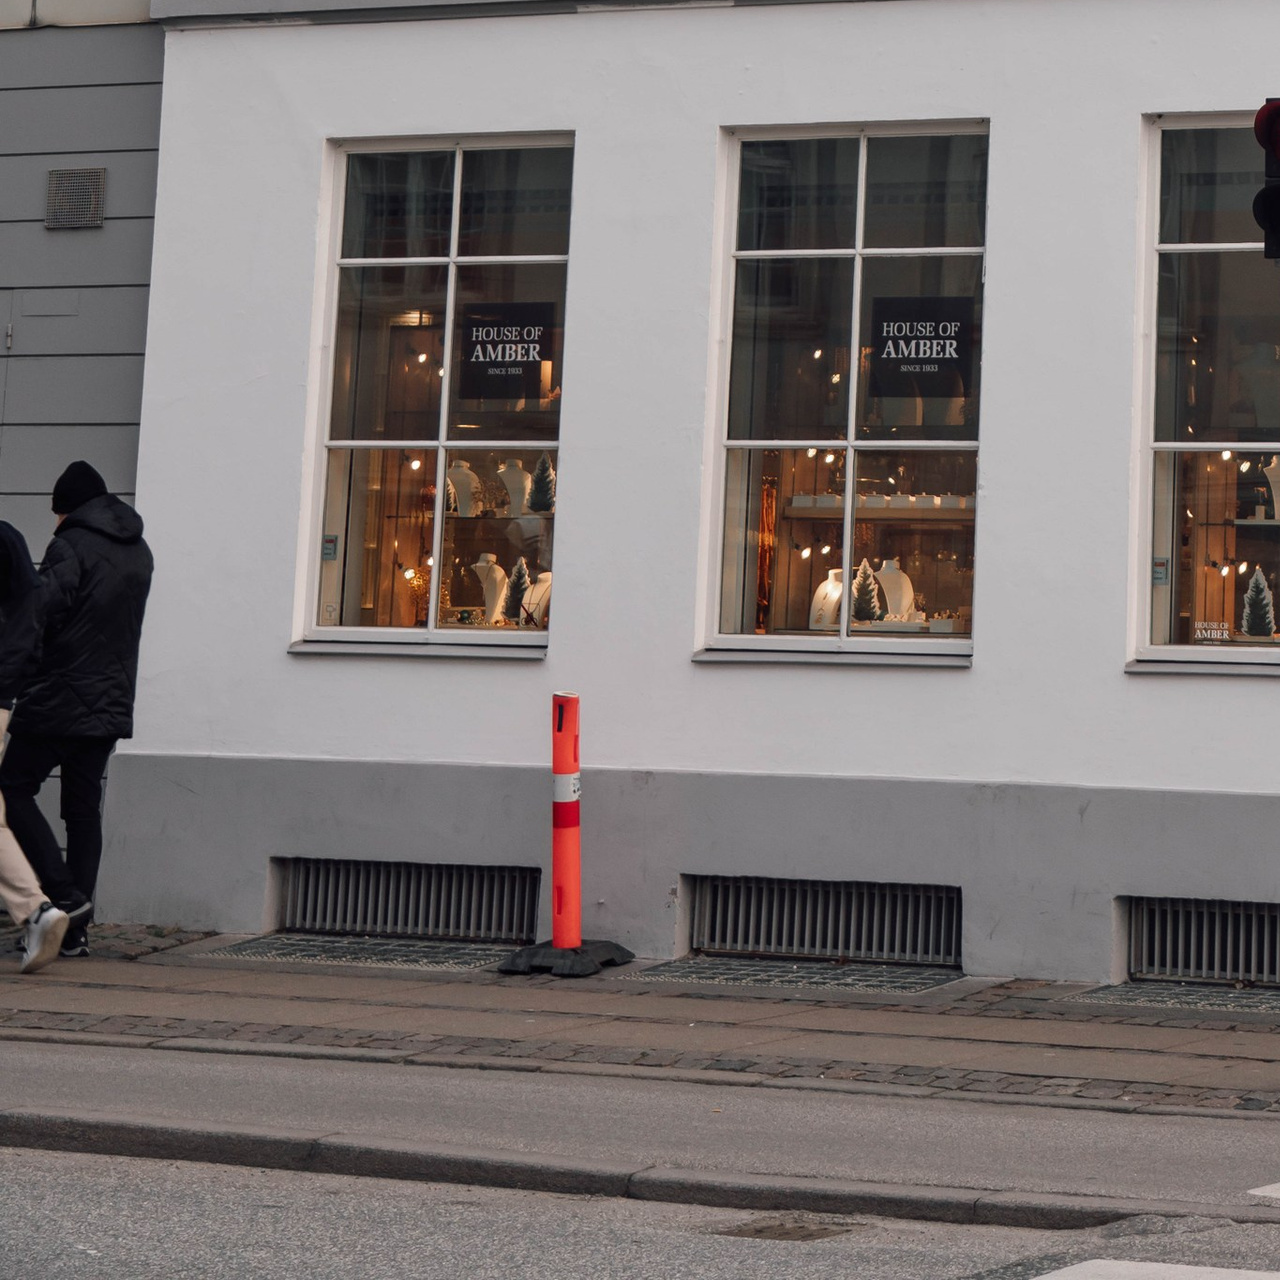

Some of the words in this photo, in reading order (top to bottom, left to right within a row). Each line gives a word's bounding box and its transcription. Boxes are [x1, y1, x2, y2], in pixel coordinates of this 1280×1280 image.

[471, 326, 521, 341] HOUSE
[523, 326, 543, 341] OF
[881, 321, 936, 337] HOUSE
[938, 321, 961, 337] OF
[470, 343, 541, 361] AMBER
[881, 339, 959, 358] AMBER
[487, 367, 506, 375] SINCE
[507, 367, 523, 375] 1933
[900, 364, 921, 372] SINCE
[922, 364, 939, 372] 1933
[1194, 621, 1219, 629] HOUSE
[1194, 629, 1230, 639] AMBER
